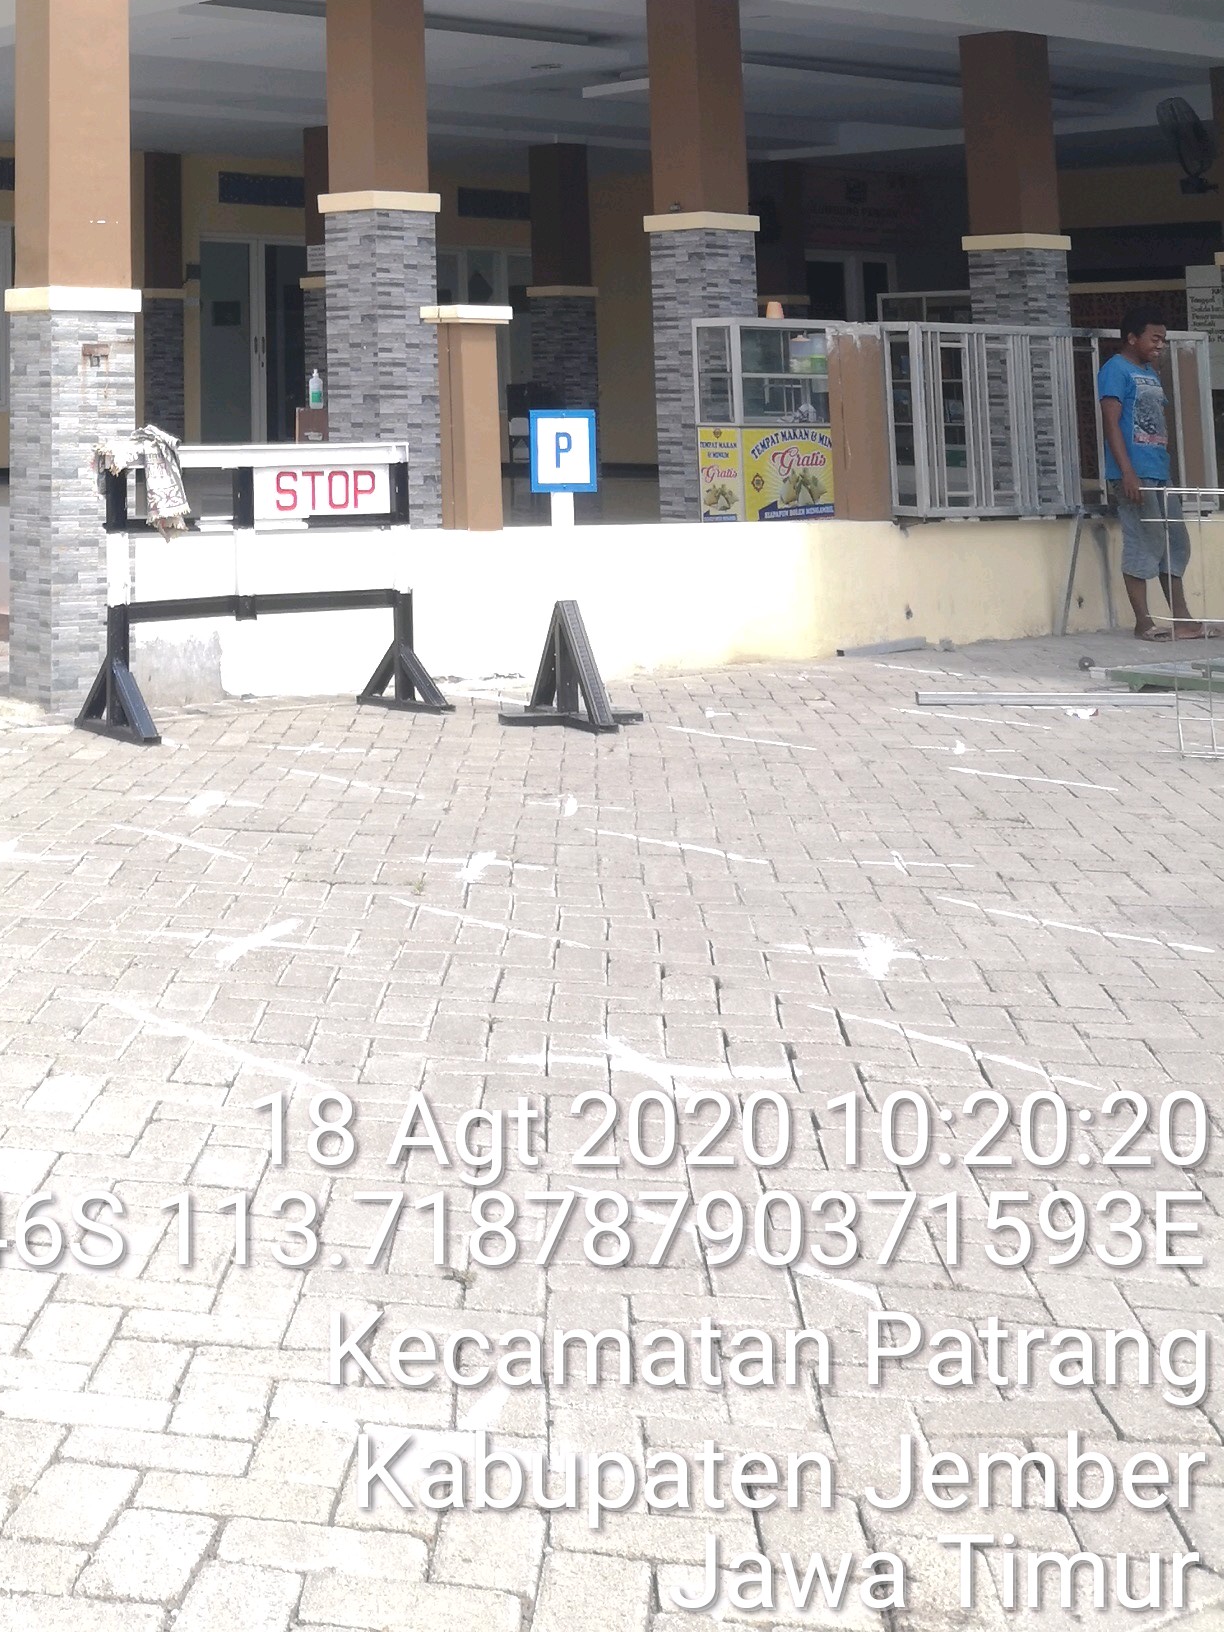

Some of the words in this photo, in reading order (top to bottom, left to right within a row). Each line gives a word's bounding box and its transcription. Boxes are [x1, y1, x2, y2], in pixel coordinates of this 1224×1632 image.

[555, 431, 573, 469] P
[750, 433, 779, 459] TEMPAT
[781, 428, 809, 442] MAKAN
[811, 430, 818, 442] &
[700, 465, 739, 483] Gratis
[771, 446, 827, 477] Gratis
[276, 470, 376, 511] STOP
